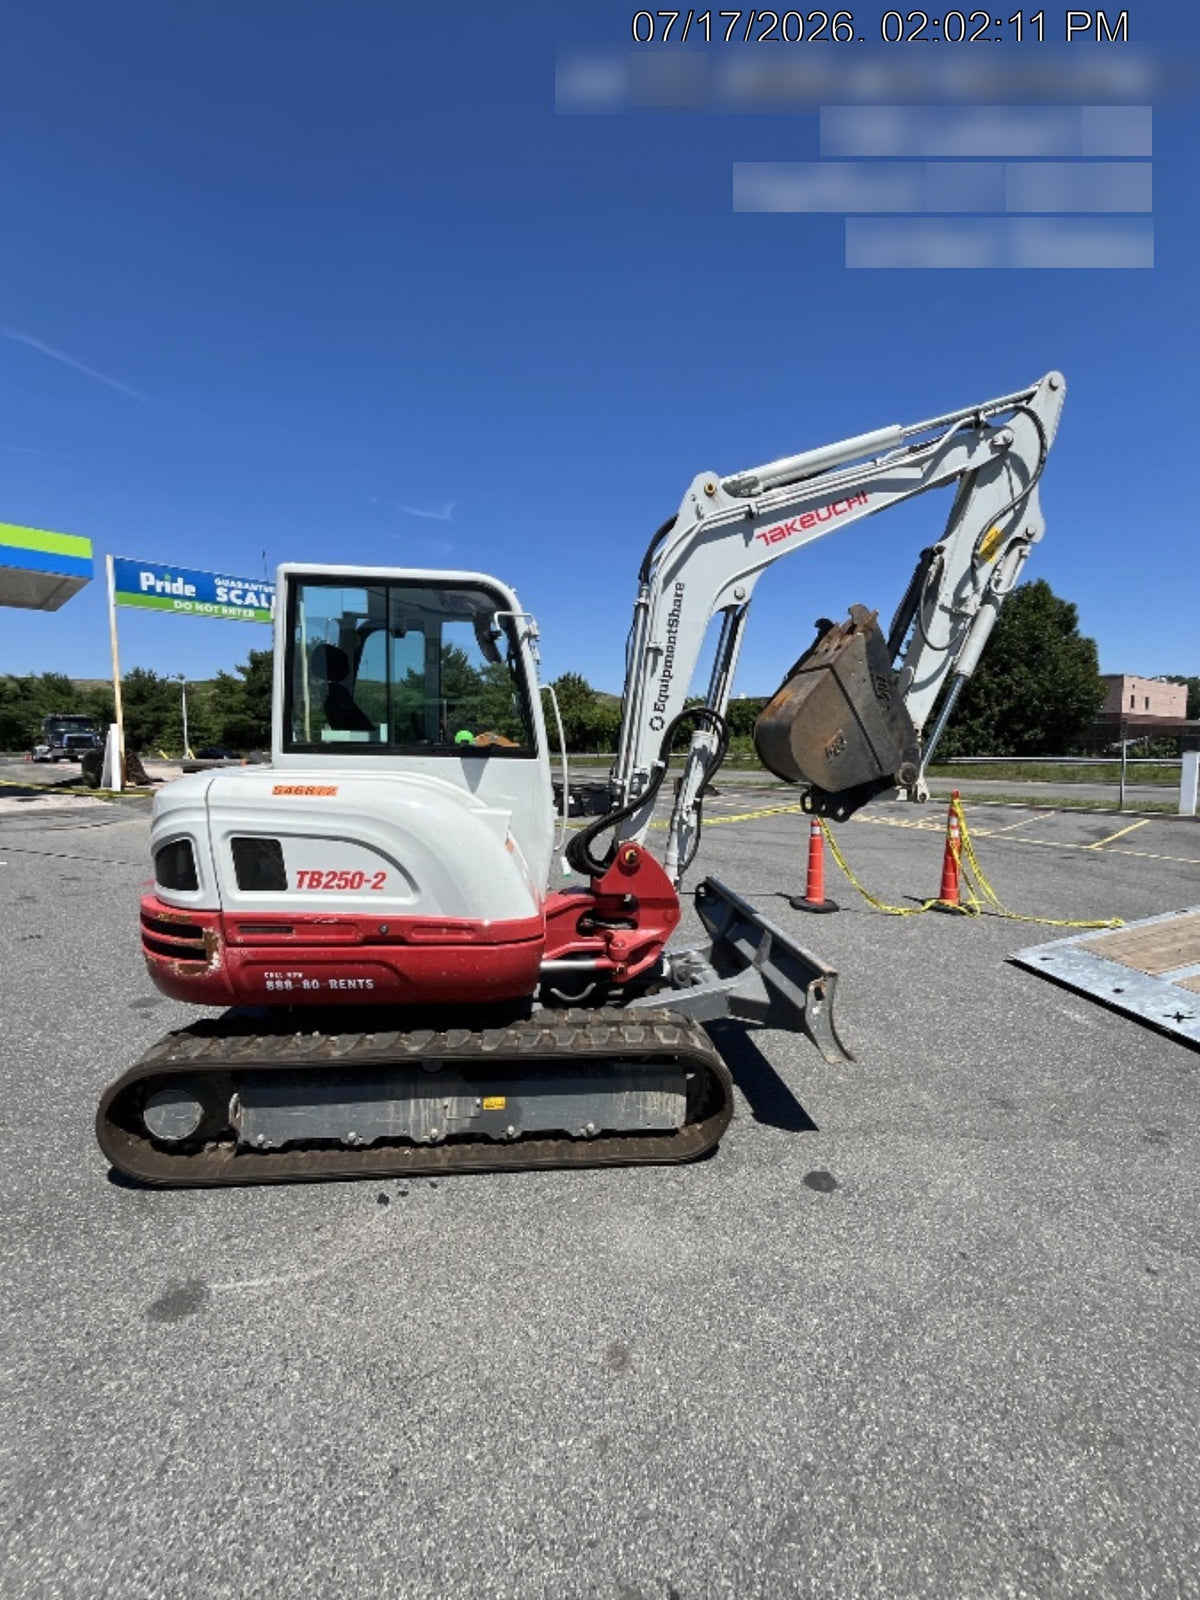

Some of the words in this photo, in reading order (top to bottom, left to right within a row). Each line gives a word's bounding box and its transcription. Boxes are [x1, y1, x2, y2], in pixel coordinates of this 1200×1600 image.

[755, 490, 869, 547] TAKEUCHI
[139, 571, 196, 597] Pride
[173, 600, 192, 611] DO
[195, 602, 220, 614] NOT
[221, 606, 255, 618] ENTER
[653, 582, 685, 714] EquipmentShare
[296, 870, 387, 890] TB250-2
